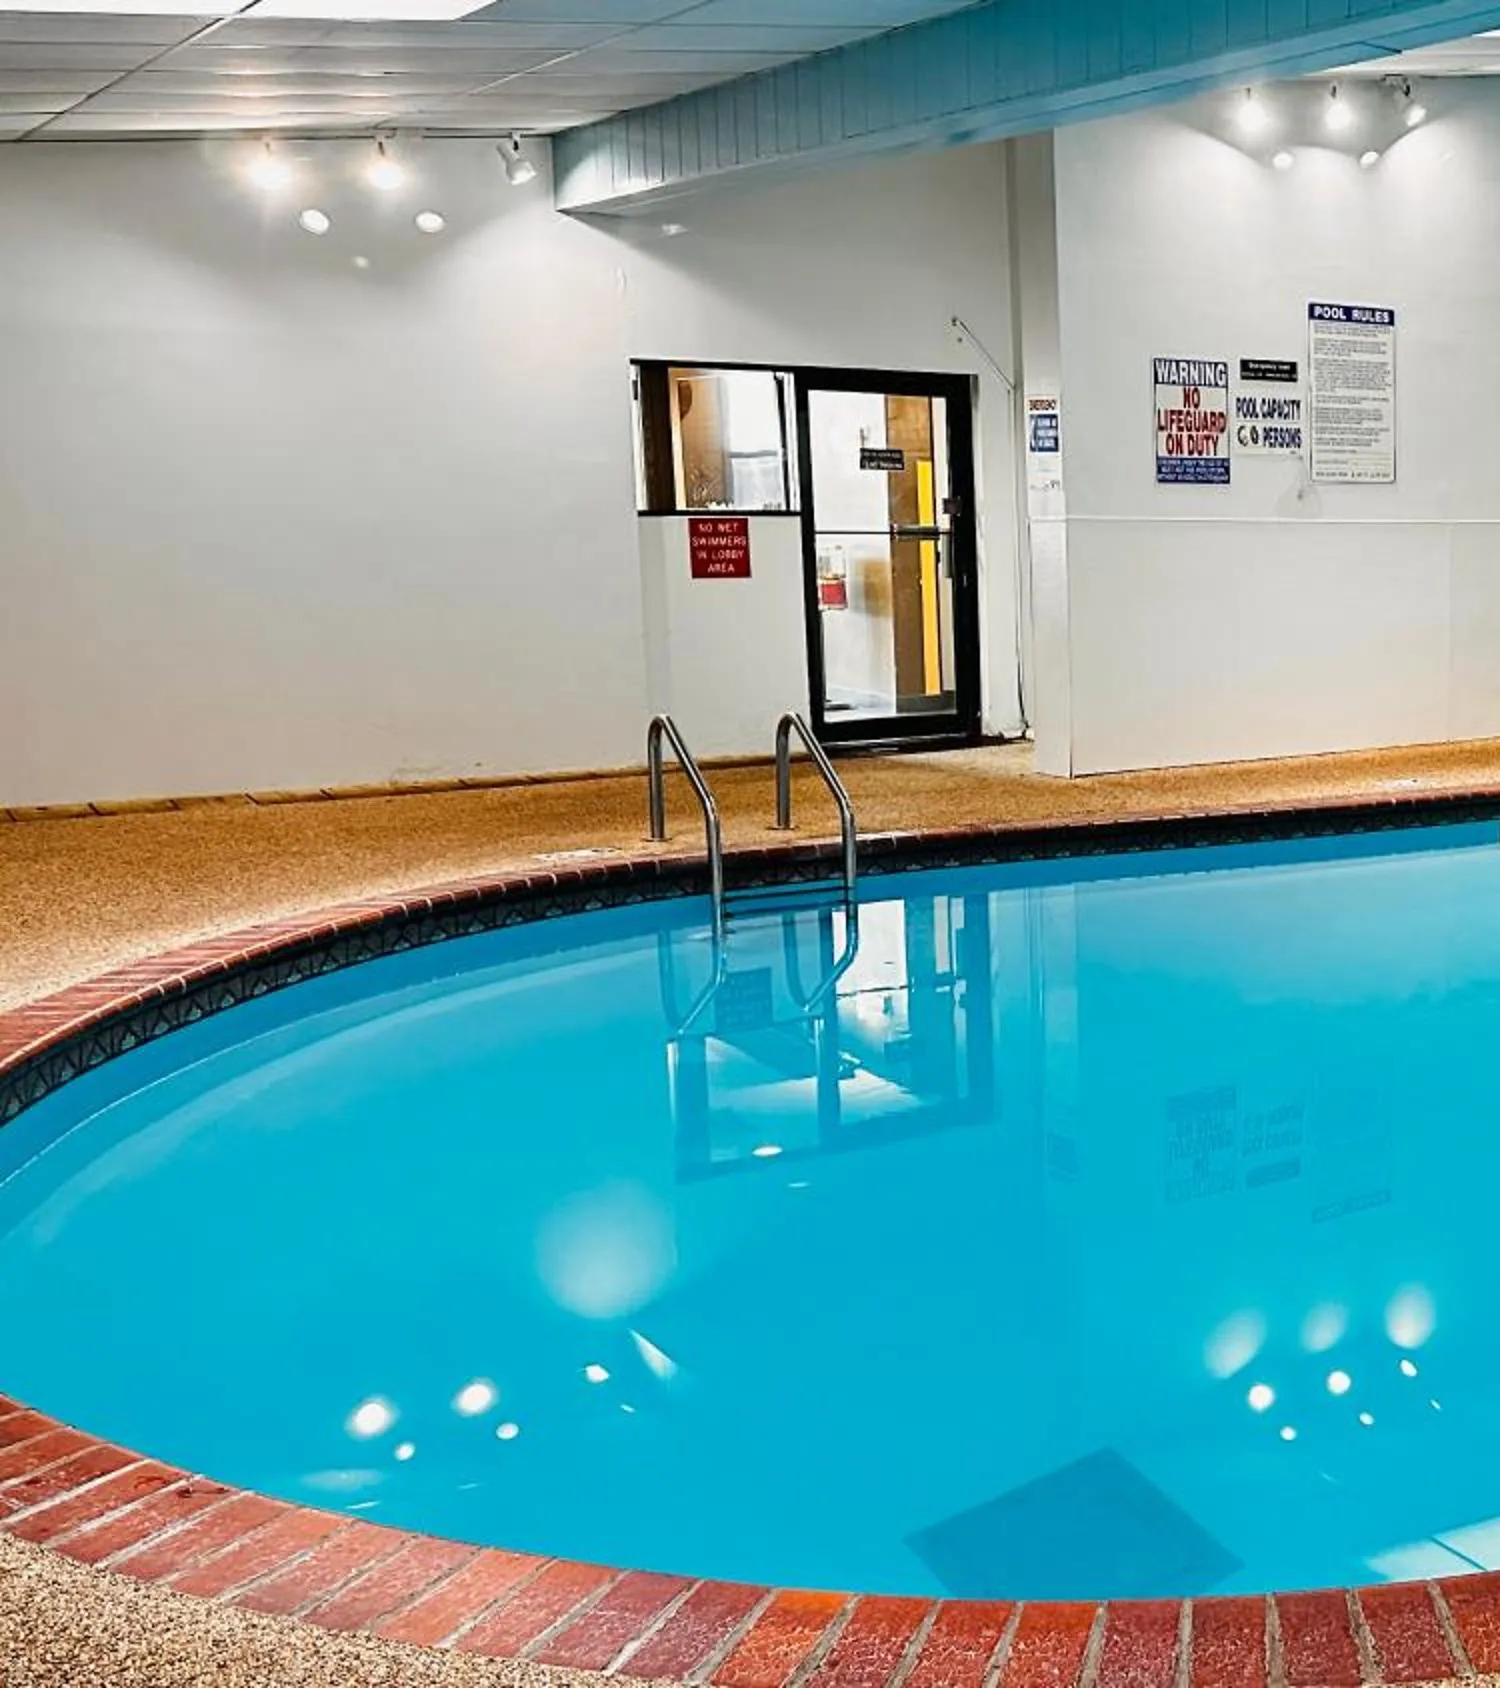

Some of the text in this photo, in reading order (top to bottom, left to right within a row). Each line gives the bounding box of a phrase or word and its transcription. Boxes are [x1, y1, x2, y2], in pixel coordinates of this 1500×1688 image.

[1313, 305, 1390, 323] POOL RULES
[1156, 359, 1226, 386] WARNING
[1183, 387, 1201, 409] NO
[1236, 397, 1259, 419] POOL
[1260, 397, 1301, 421] CAPACITY
[1157, 408, 1226, 433] LIFEGUARD
[1166, 433, 1219, 456] ON DUTY
[1263, 427, 1302, 449] PERSONS
[698, 522, 713, 533] NO
[691, 535, 747, 547] SWIMMERS
[696, 549, 745, 560] IN LOBBY
[707, 562, 735, 573] AREA
